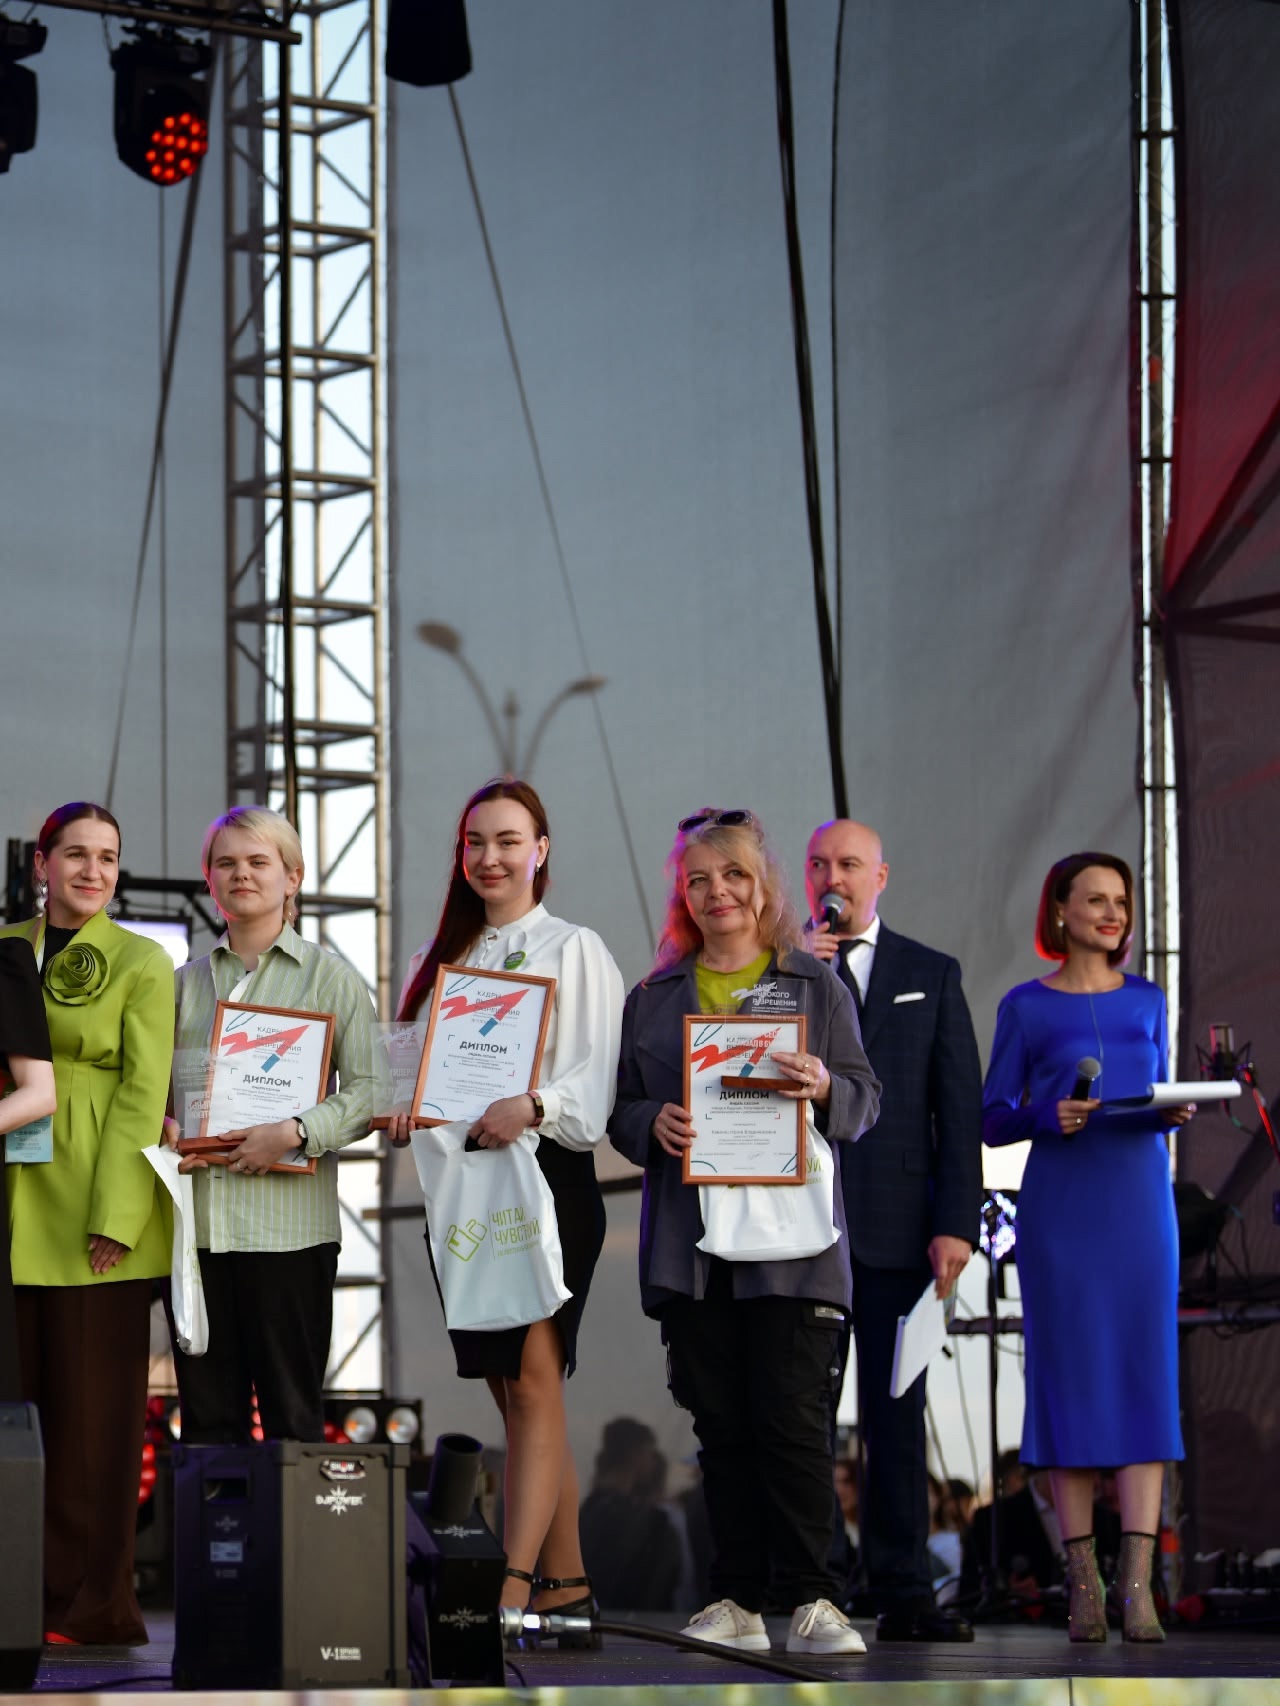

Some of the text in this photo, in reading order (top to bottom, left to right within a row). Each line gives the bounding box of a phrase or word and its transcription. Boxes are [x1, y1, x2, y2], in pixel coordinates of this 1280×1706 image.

[460, 1041, 507, 1055] ДИПЛОМ
[243, 1074, 292, 1088] ДИПЛОМ
[719, 1091, 770, 1101] ДИПЛОМ
